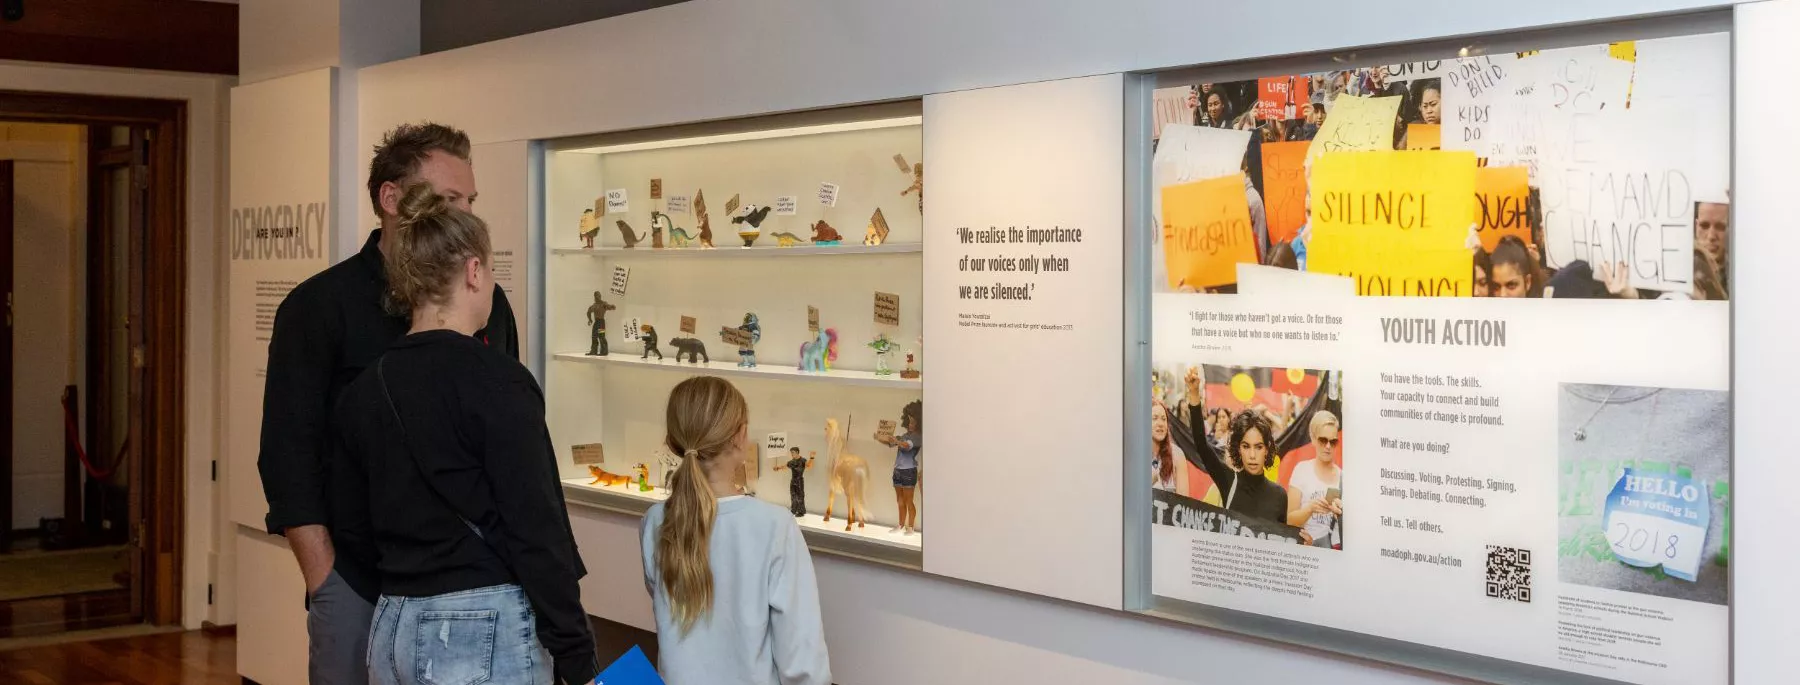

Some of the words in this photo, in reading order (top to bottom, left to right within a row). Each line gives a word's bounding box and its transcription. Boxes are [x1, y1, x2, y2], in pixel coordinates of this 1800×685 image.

[1458, 105, 1490, 123] KIDS
[1464, 126, 1481, 142] DO
[1541, 168, 1691, 220] DEMAND
[1319, 190, 1432, 230] SILENCE
[232, 202, 326, 260] DEMOCRACY
[256, 228, 268, 239] ARE
[270, 227, 284, 238] YOU
[286, 227, 294, 238] IN
[976, 227, 1006, 244] realise
[1008, 226, 1024, 243] the
[1026, 226, 1082, 246] importance
[1545, 210, 1688, 284] CHANGE
[959, 254, 968, 272] of
[970, 258, 986, 272] our
[988, 254, 1016, 272] voices
[1018, 254, 1040, 274] only
[1042, 254, 1069, 272] when
[958, 286, 972, 300] we
[974, 286, 988, 300] are
[1195, 311, 1208, 322] fight
[1218, 312, 1234, 322] those
[1235, 312, 1247, 322] who
[1271, 314, 1281, 324] got
[1288, 313, 1305, 324] voice.
[1306, 314, 1314, 324] Or
[1315, 314, 1324, 324] for
[1326, 314, 1343, 325] those
[1191, 328, 1203, 336] that
[1204, 328, 1217, 337] have
[1223, 328, 1238, 337] voice
[1238, 329, 1248, 338] but
[1250, 329, 1262, 338] who
[1272, 331, 1283, 339] one
[1284, 331, 1302, 340] wants
[1303, 331, 1310, 340] to
[1312, 331, 1328, 341] listen
[1380, 318, 1436, 344] YOUTH
[1442, 319, 1506, 347] ACTION
[1380, 372, 1393, 384] You
[1394, 374, 1410, 384] have
[1412, 374, 1423, 385] the
[1425, 375, 1444, 386] tools.
[1447, 376, 1459, 387] The
[1460, 376, 1482, 388] skills.
[1380, 390, 1395, 401] Your
[1397, 391, 1425, 404] capacity
[1427, 393, 1434, 403] to
[1436, 394, 1463, 405] connect
[1464, 395, 1478, 406] and
[1480, 396, 1499, 407] build
[1380, 408, 1423, 420] communities
[1424, 410, 1432, 421] of
[1434, 412, 1458, 424] change
[1460, 413, 1466, 423] is
[1468, 414, 1504, 426] profound.
[1380, 437, 1398, 449] What
[1399, 440, 1410, 450] are
[1412, 442, 1424, 452] you
[1426, 441, 1450, 454] doing?
[1380, 468, 1417, 483] Discussing.
[1419, 472, 1444, 485] Voting.
[1446, 475, 1485, 490] Protesting.
[1486, 478, 1517, 493] Signing.
[1624, 474, 1698, 502] HELLO
[1380, 486, 1408, 499] Sharing.
[1410, 488, 1443, 503] Debating.
[1445, 492, 1486, 508] Connecting.
[1172, 504, 1216, 532] CHANGE
[1218, 513, 1241, 536] THE
[1642, 500, 1682, 516] voting
[1684, 508, 1698, 520] in
[1380, 515, 1392, 526] Tell
[1394, 519, 1404, 529] us.
[1406, 518, 1417, 530] Tell
[1419, 521, 1444, 533] others.
[1614, 522, 1679, 559] 2018
[1380, 548, 1462, 568] moadoph.gov.au/action
